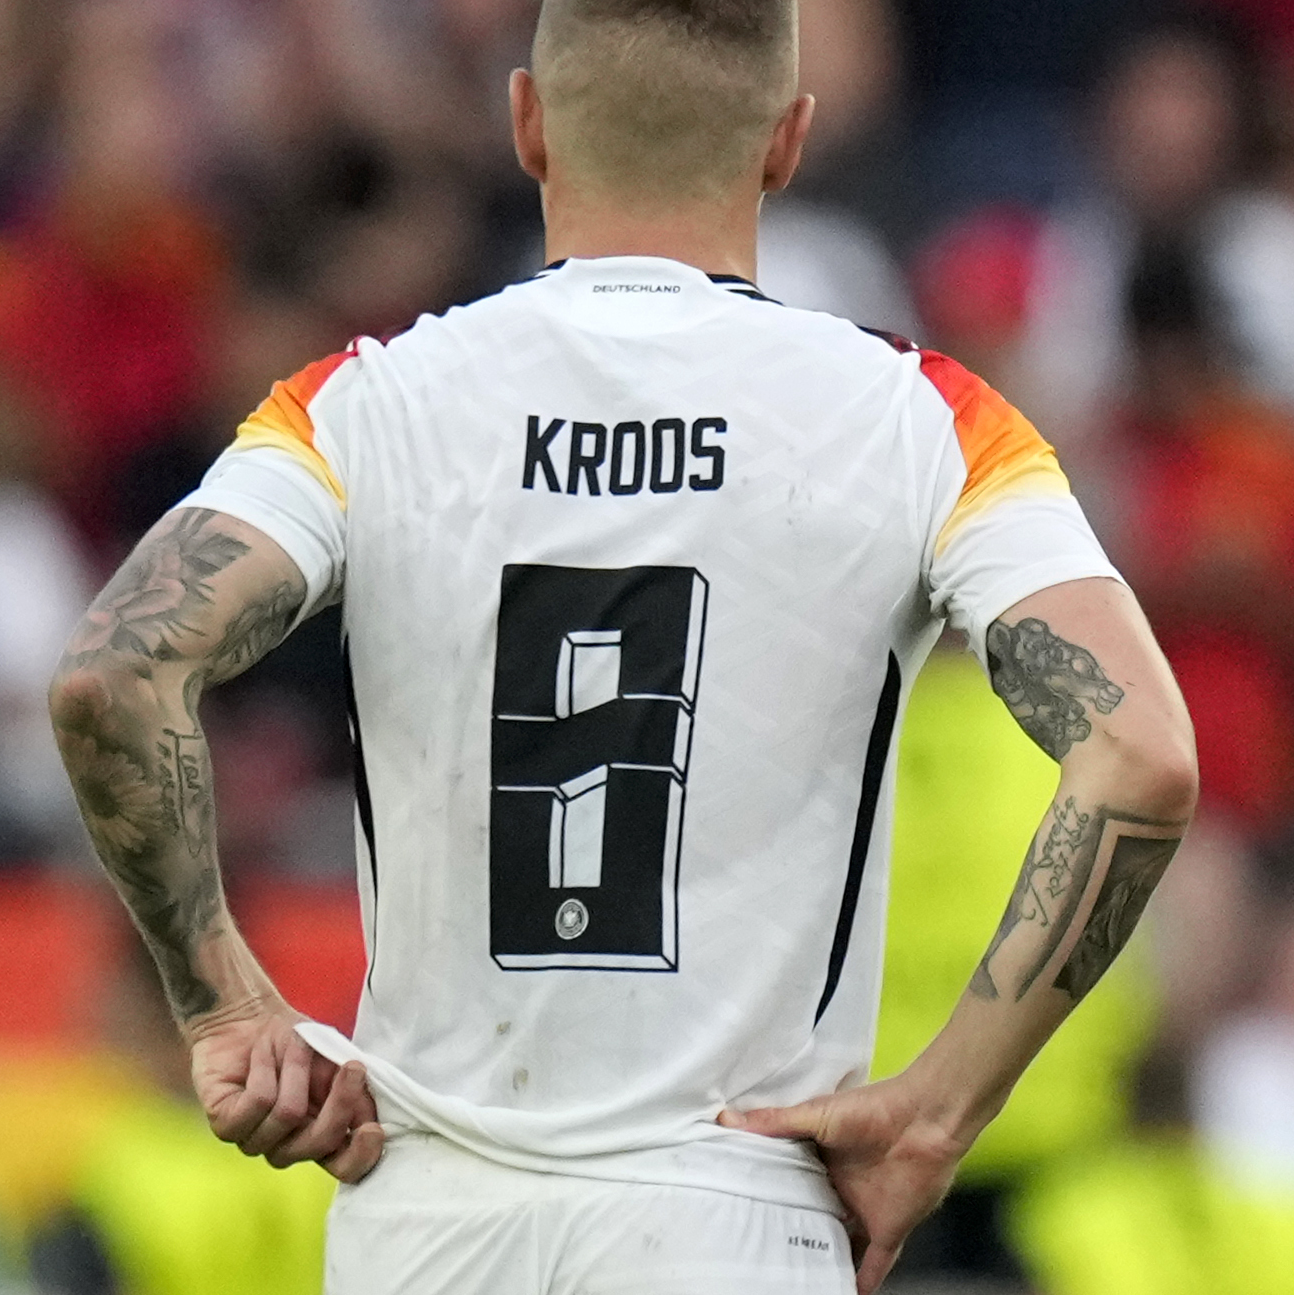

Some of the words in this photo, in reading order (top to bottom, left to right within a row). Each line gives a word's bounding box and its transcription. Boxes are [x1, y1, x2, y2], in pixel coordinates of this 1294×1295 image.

[592, 284, 681, 294] DEUTSCHLAND
[522, 414, 728, 496] KROOS
[490, 564, 710, 972] 8
